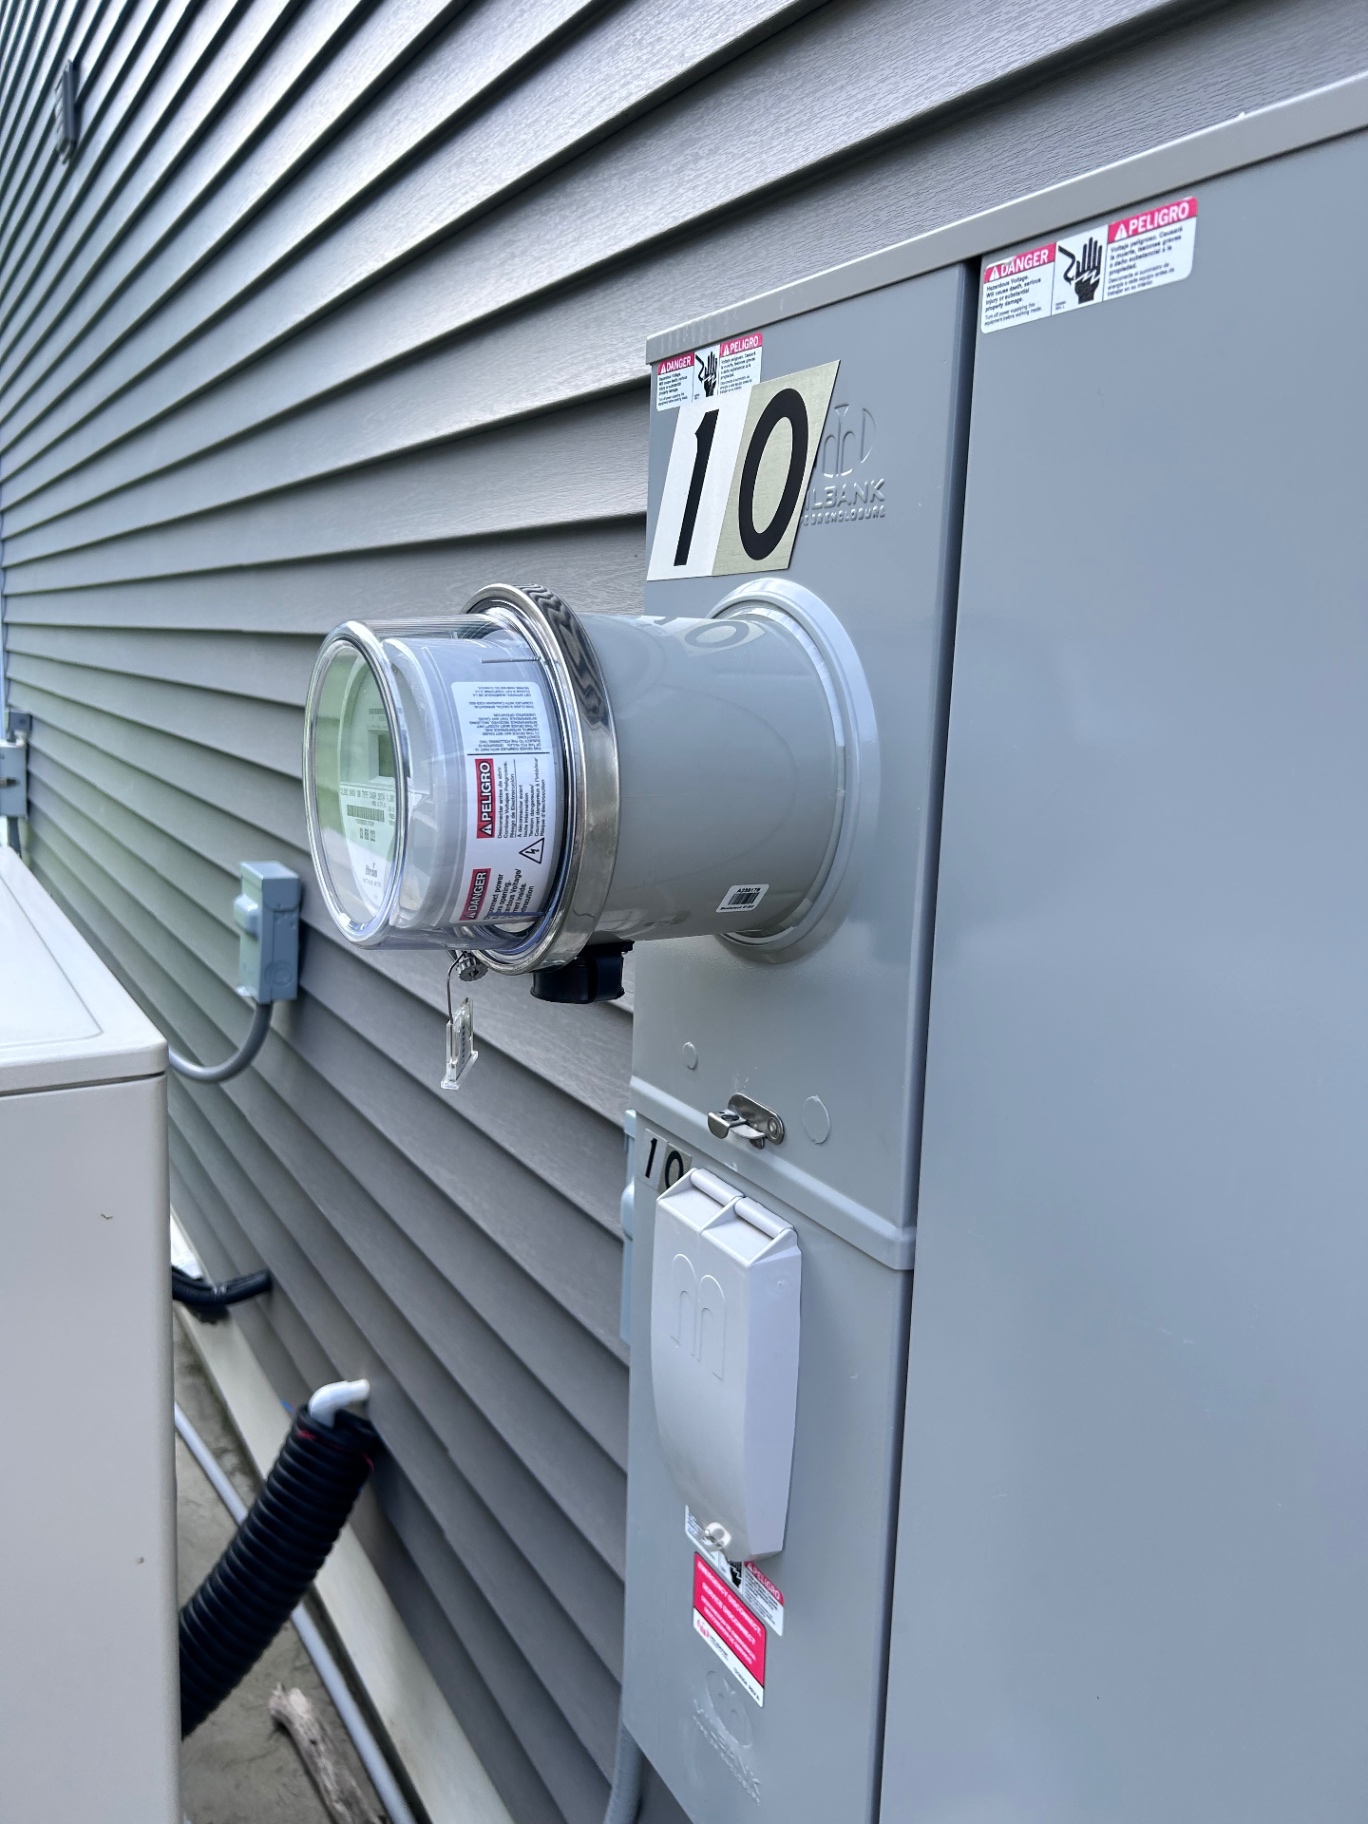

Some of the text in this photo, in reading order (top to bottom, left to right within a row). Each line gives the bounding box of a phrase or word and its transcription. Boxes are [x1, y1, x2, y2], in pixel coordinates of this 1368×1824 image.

[1129, 202, 1190, 236] PELIGRO
[1001, 248, 1049, 277] DANGER
[730, 335, 759, 353] PELIGRO
[666, 356, 692, 371] DANGER
[673, 388, 808, 566] 10
[479, 762, 492, 821] PELIGRO
[468, 872, 487, 911] DANGER
[495, 874, 504, 893] power
[498, 880, 511, 905] opening.
[509, 868, 522, 893] Voltage/
[645, 1137, 684, 1189] 10
[752, 1565, 780, 1601] PELIGRO
